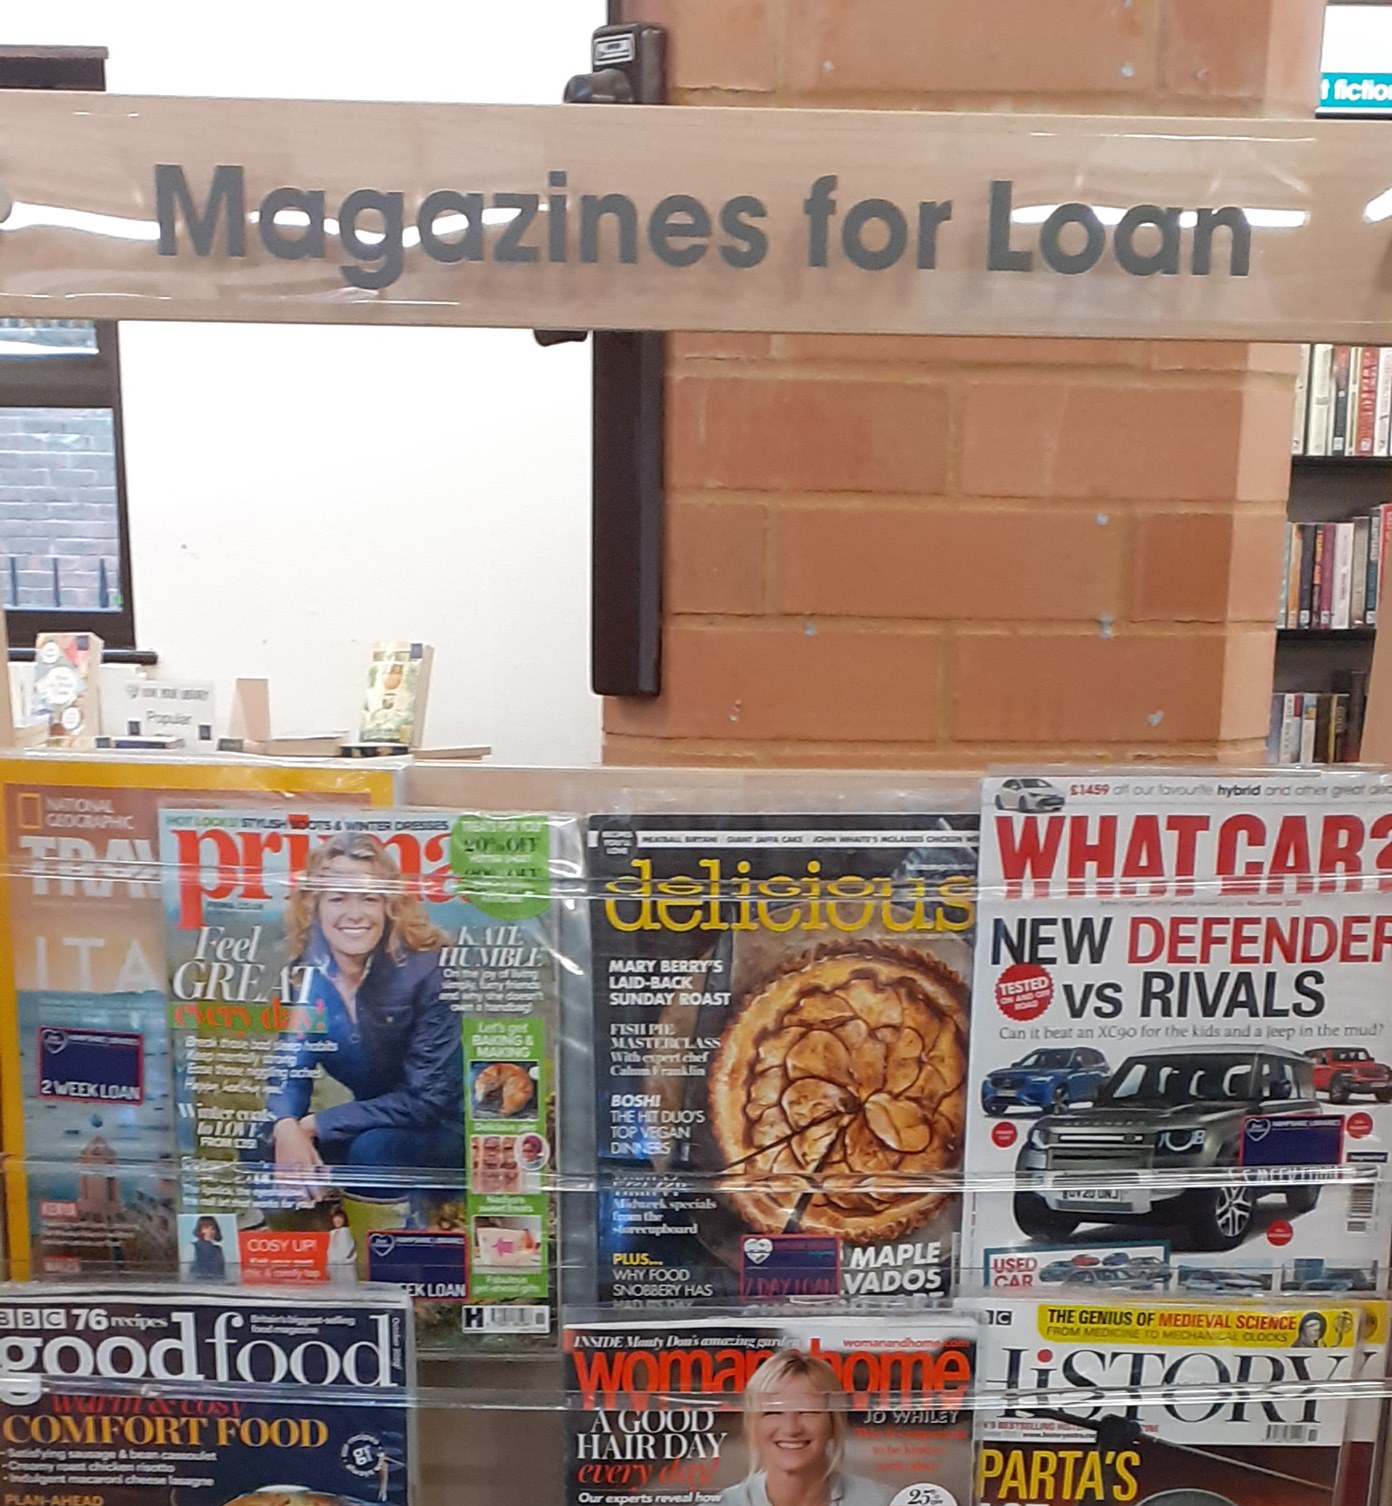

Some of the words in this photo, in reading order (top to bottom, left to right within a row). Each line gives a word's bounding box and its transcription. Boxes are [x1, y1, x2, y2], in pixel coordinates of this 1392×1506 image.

[154, 164, 769, 289] Magazines
[808, 175, 952, 271] for
[987, 181, 1253, 276] Loan
[146, 710, 191, 727] Popular
[46, 799, 113, 813] NATIONAL
[46, 814, 134, 829] GEOGRAPHIC
[995, 815, 1210, 900] WHAT
[604, 858, 976, 933] delicious
[194, 926, 261, 963] Feel
[457, 926, 525, 947] KATE
[990, 917, 1113, 965] NEW
[609, 960, 657, 973] MARY
[661, 960, 723, 973] BERRY'S
[173, 962, 321, 1003] GREAT
[609, 976, 692, 989] LAID-BACK
[609, 993, 675, 1006] SUNDAY
[679, 993, 731, 1006] ROAST
[1140, 969, 1326, 1019] RIVALS
[1000, 1027, 1027, 1040] Can
[1030, 1027, 1041, 1040] it
[1044, 1026, 1072, 1040] beat
[1077, 1028, 1094, 1039] an
[1098, 1026, 1137, 1040] XC90
[1141, 1025, 1163, 1039] for
[1165, 1025, 1188, 1039] the
[1191, 1025, 1221, 1039] kids
[1224, 1025, 1251, 1038] and
[1254, 1027, 1263, 1038] a
[1265, 1025, 1296, 1042] Jeep
[1300, 1025, 1315, 1037] in
[1318, 1024, 1340, 1037] the
[1344, 1023, 1384, 1036] mud?
[41, 1080, 50, 1094] 2
[51, 1081, 98, 1098] WEEK
[100, 1084, 141, 1100] LOAN
[611, 1126, 638, 1139] TOP
[641, 1126, 690, 1139] VEGAN
[850, 1242, 941, 1269] MAPLE
[993, 1258, 1038, 1274] USED
[613, 1269, 646, 1282] WHY
[649, 1269, 689, 1282] FOOD
[428, 1284, 466, 1298] LOAN
[71, 1309, 108, 1331] 76
[111, 1315, 168, 1329] recipes
[1048, 1309, 1075, 1323] THE
[1078, 1310, 1133, 1325] GENIUS
[1136, 1312, 1155, 1326] OF
[1159, 1313, 1232, 1329] MEDIEVAL
[1235, 1315, 1296, 1330] SCIENCE
[1046, 1326, 1081, 1337] FROM
[1084, 1328, 1141, 1340] MEDICINE
[1145, 1329, 1159, 1340] TO
[1161, 1329, 1239, 1342] MECHANICAL
[1243, 1332, 1288, 1343] CLOCKS
[0, 1312, 205, 1405] good
[205, 1312, 398, 1387] food
[3, 1415, 209, 1445] COMFORT
[216, 1418, 329, 1448] FOOD
[576, 1433, 657, 1460] HAIR
[664, 1433, 728, 1460] DAY
[978, 1450, 1141, 1501] PARTA'S
